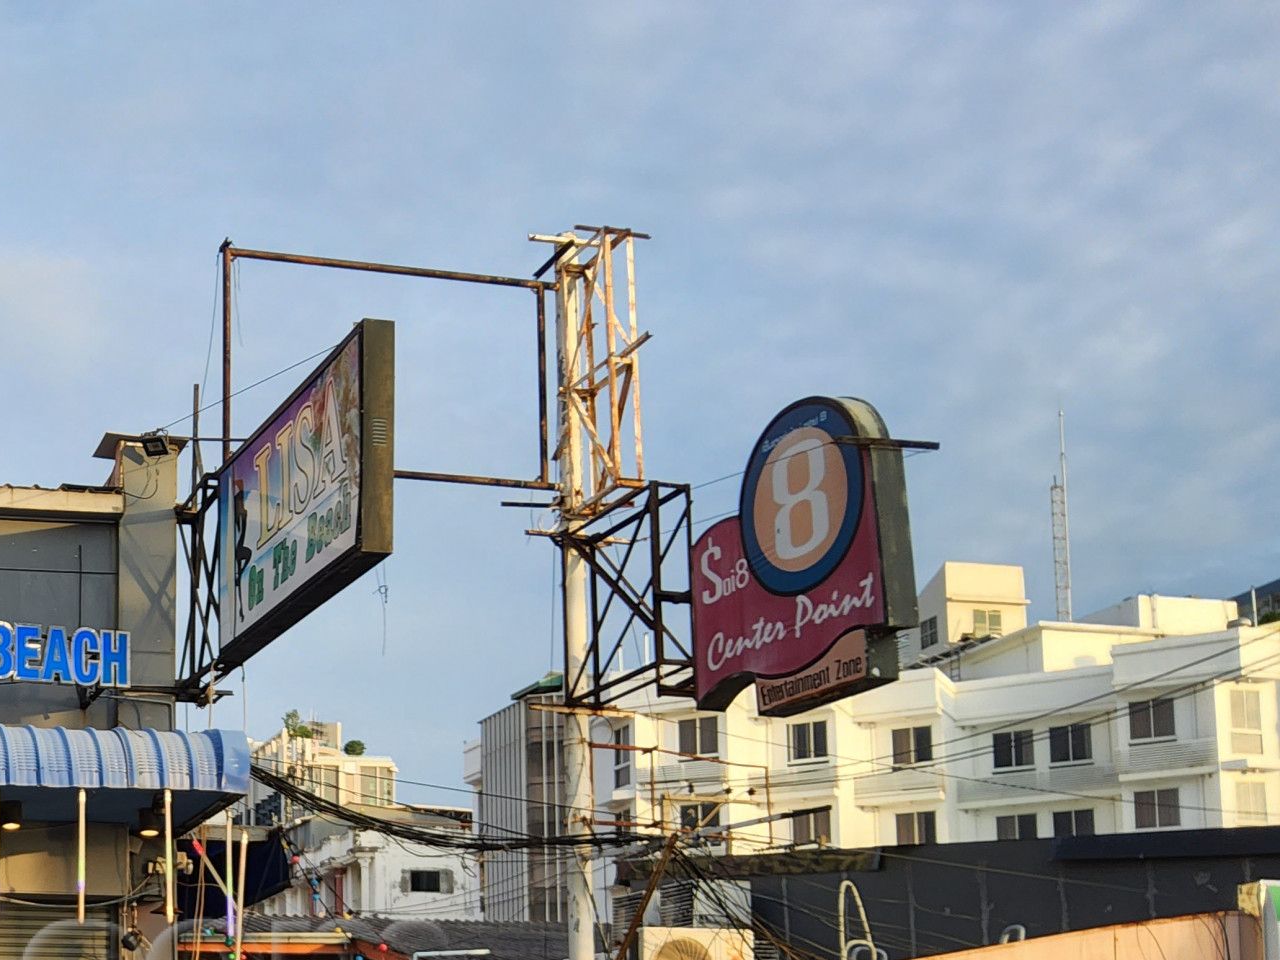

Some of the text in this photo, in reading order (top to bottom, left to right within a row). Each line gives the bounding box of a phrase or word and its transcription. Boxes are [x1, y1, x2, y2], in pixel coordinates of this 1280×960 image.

[254, 377, 348, 550] LISA
[772, 438, 831, 561] 8
[248, 481, 352, 611] On The Beach
[707, 572, 876, 671] Center Point
[760, 654, 864, 707] Entertainment Zone
